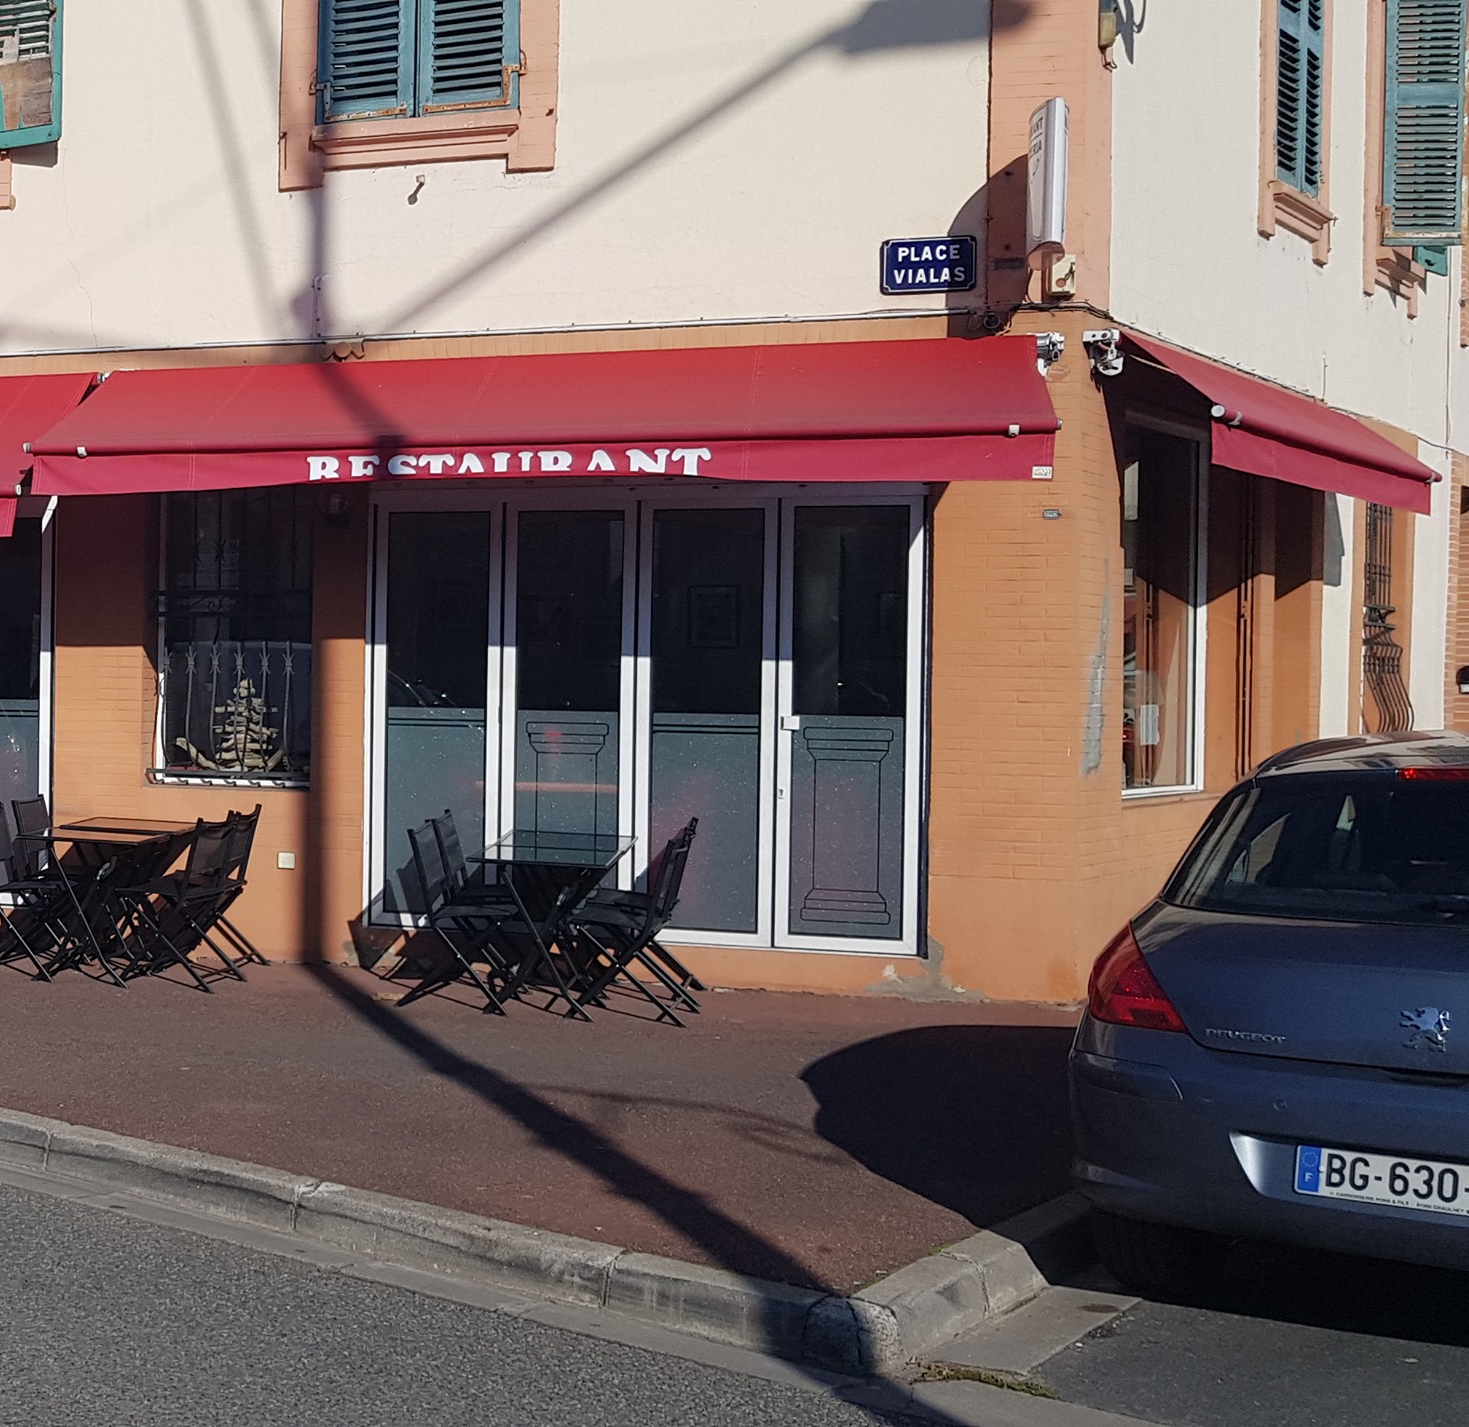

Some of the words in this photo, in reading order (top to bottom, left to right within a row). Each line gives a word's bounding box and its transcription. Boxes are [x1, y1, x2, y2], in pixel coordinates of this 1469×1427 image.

[897, 244, 960, 262] PLACE
[893, 266, 966, 284] VIALAS
[307, 447, 712, 481] RESTAURANT
[1205, 1028, 1286, 1044] PEUGEOT
[1304, 1172, 1313, 1183] F
